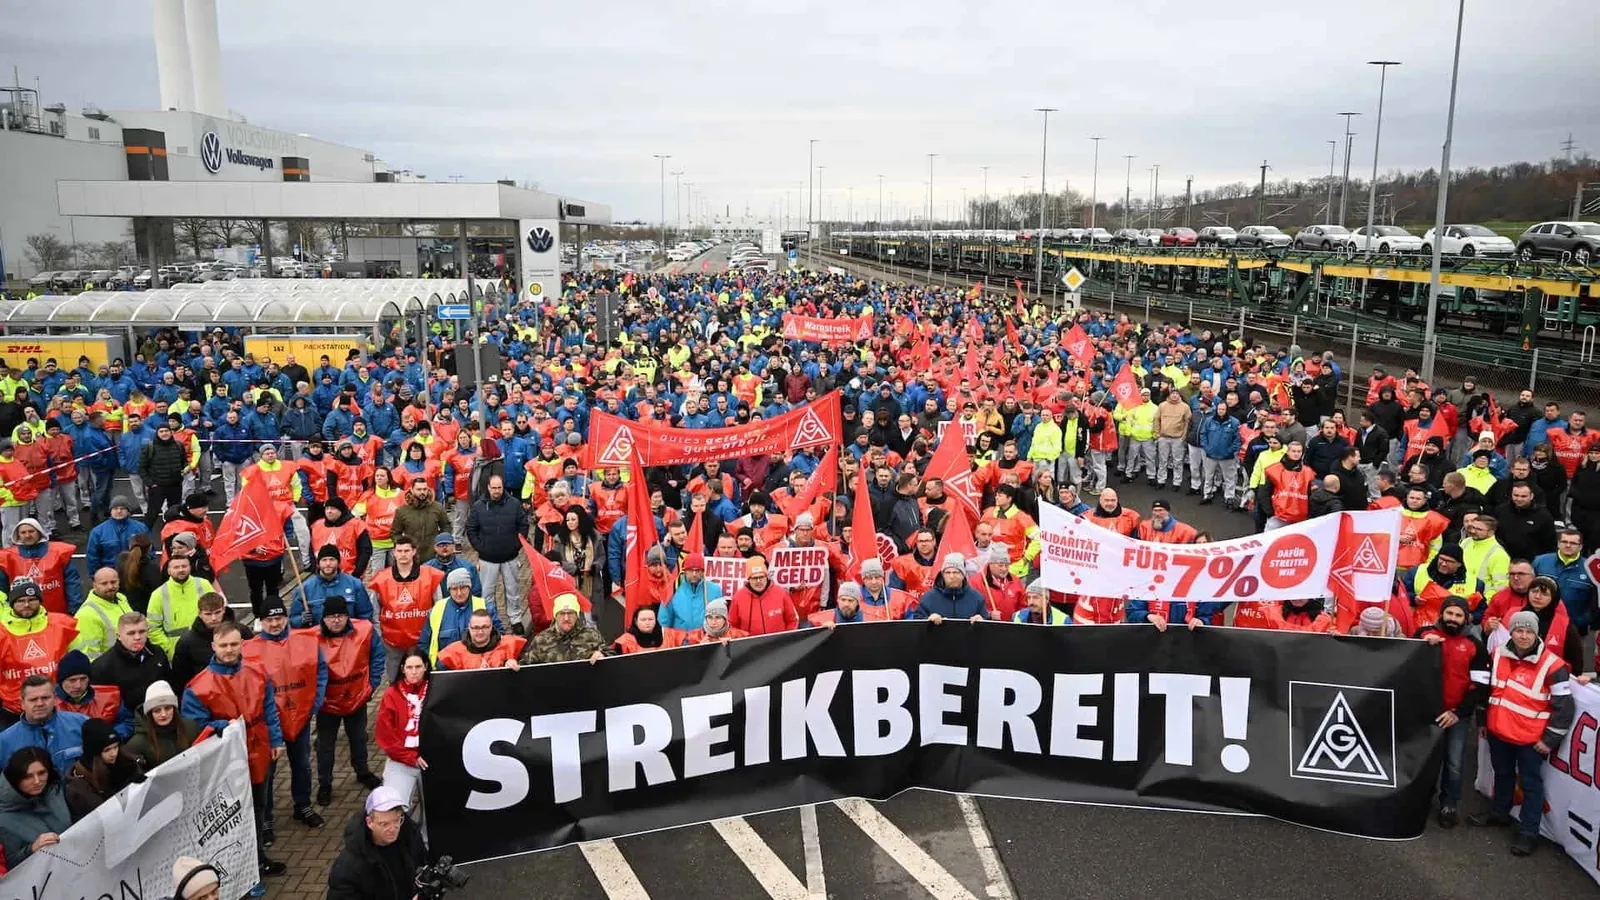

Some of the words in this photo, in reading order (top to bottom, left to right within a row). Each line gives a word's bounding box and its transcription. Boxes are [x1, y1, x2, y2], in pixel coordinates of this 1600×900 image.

[226, 148, 274, 171] Volkswagen
[804, 321, 852, 333] Warnstreik
[8, 345, 43, 353] DHL
[684, 445, 717, 455] gute
[774, 550, 826, 567] MEHR
[1048, 545, 1099, 563] GEWINNT
[1277, 547, 1305, 558] DAFÜR
[705, 560, 747, 578] MEH
[1122, 545, 1169, 571] FÜR
[1171, 554, 1259, 598] 7%
[1269, 558, 1309, 568] STREITEN
[776, 567, 822, 584] GELD
[1278, 568, 1297, 576] WIR
[1240, 608, 1256, 618] Wir
[3, 669, 21, 680] Wir
[462, 663, 1251, 811] STREIKBEREIT!
[197, 800, 228, 833] LEBEN
[218, 813, 243, 838] WIR!
